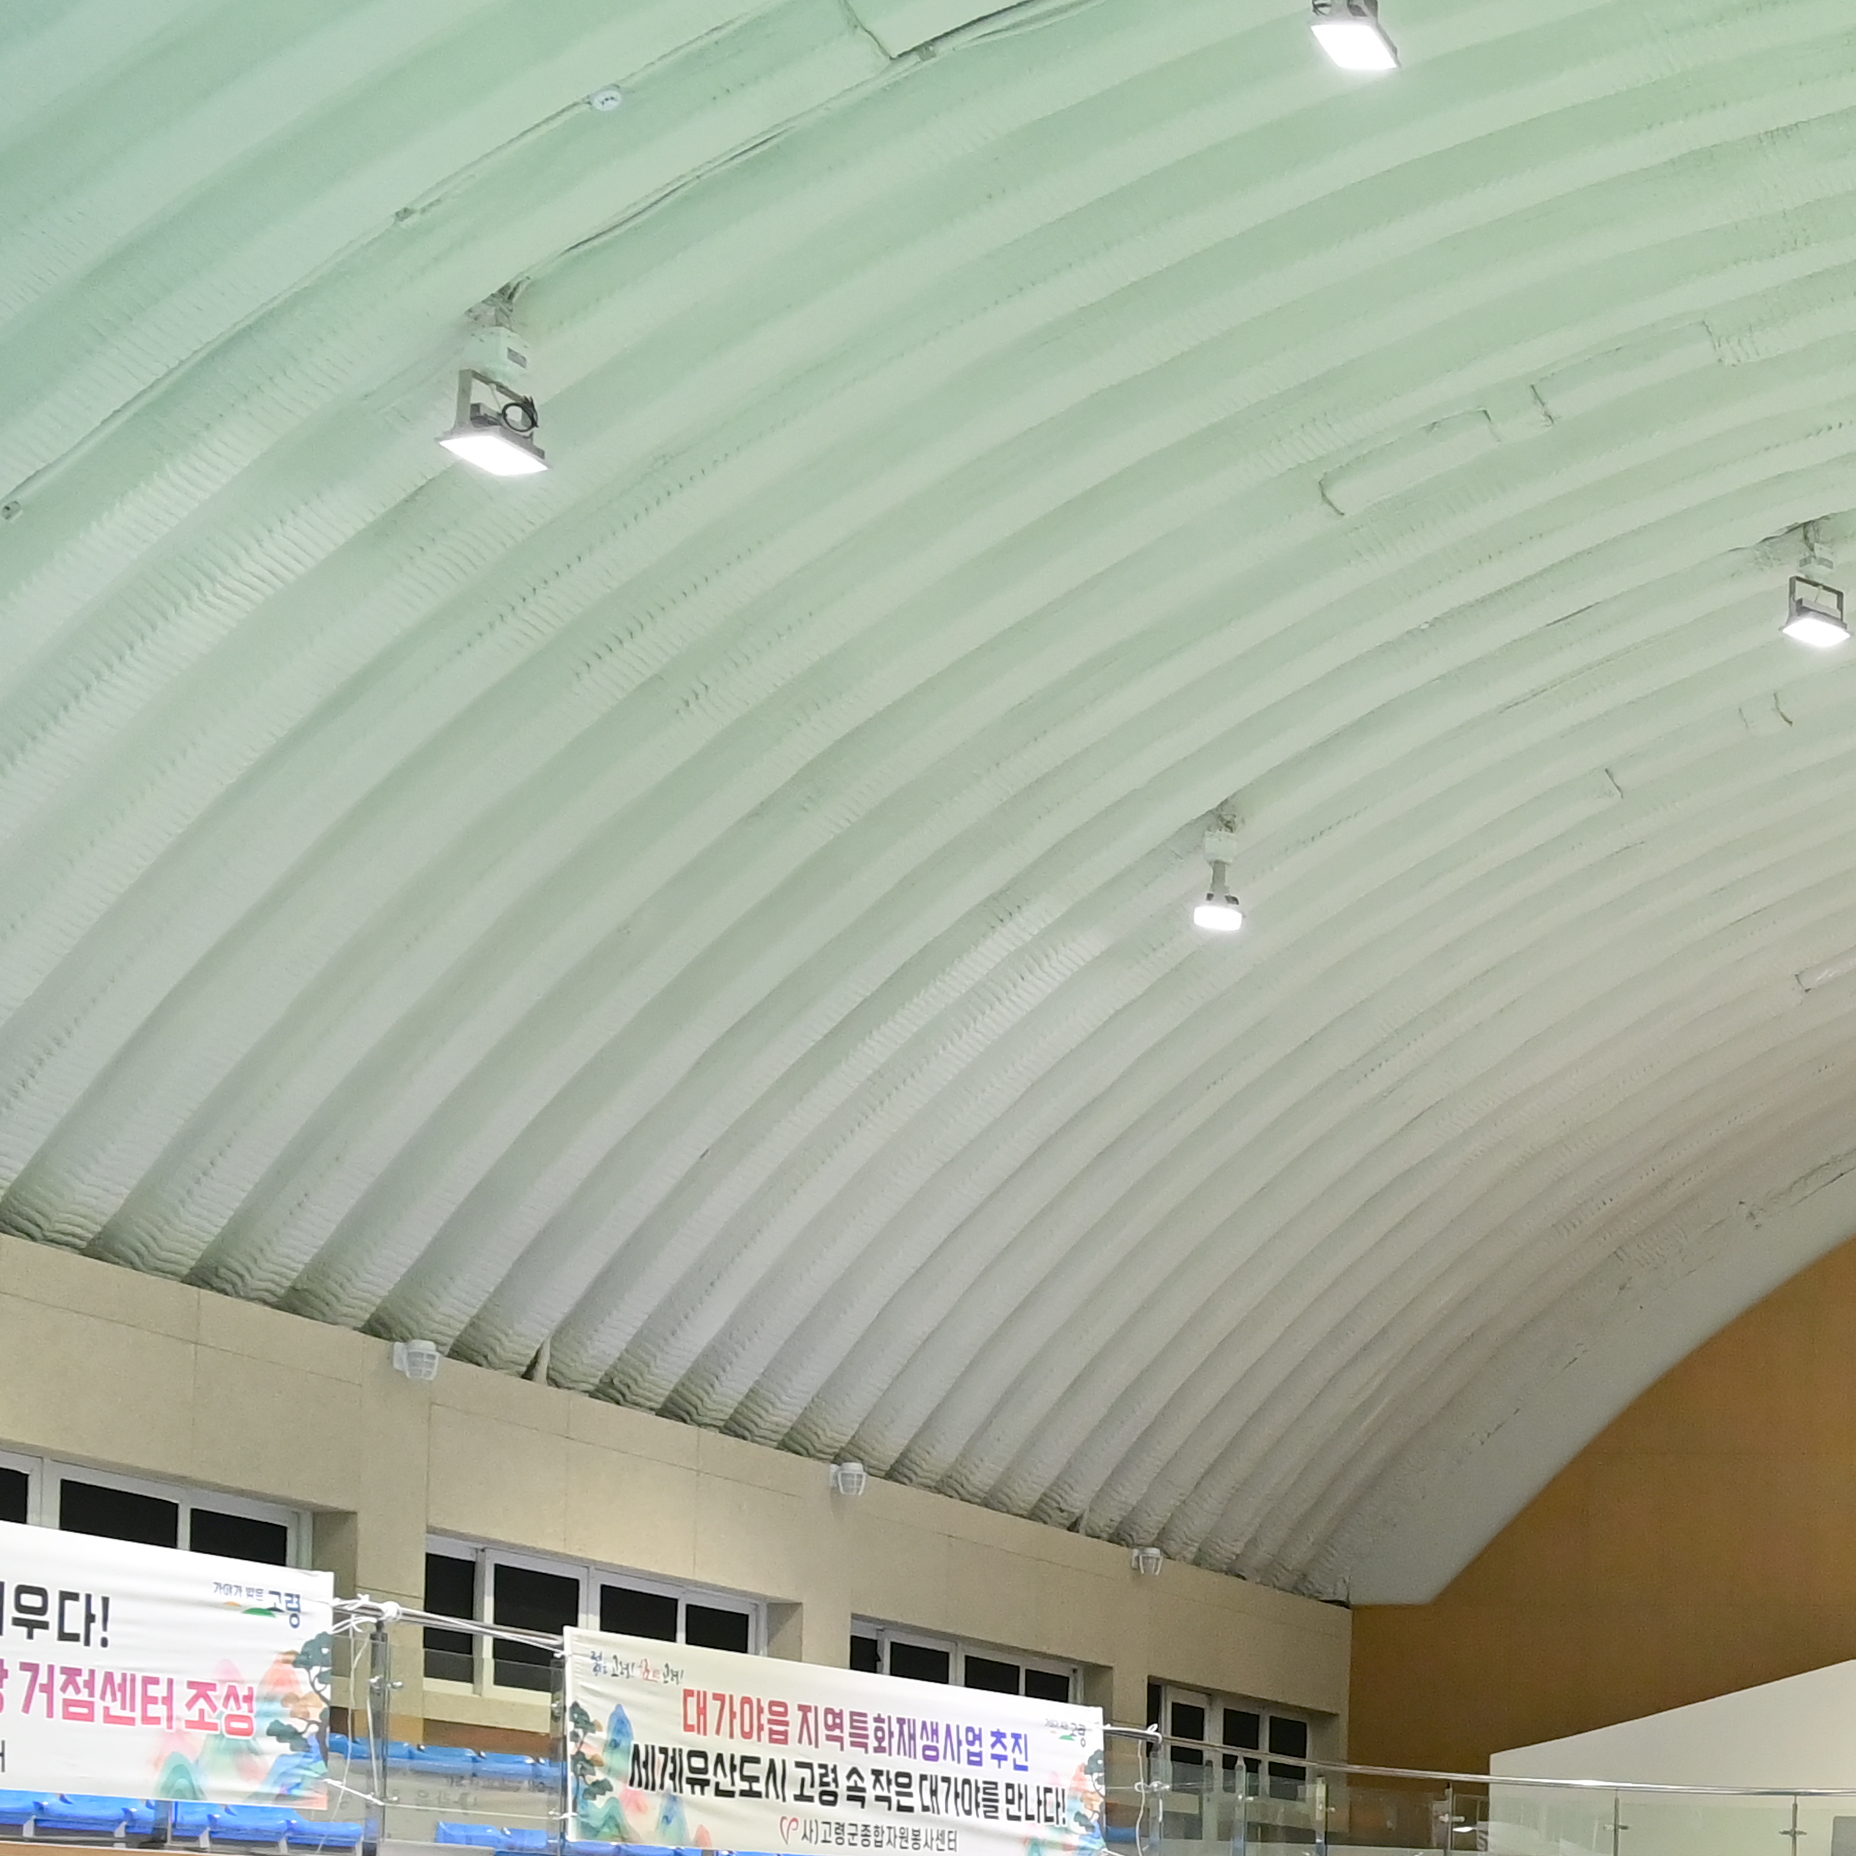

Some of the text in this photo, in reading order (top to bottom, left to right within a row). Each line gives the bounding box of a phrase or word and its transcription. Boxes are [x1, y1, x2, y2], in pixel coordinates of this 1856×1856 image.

[0, 1581, 110, 1648] 우다!
[213, 1581, 243, 1598] 가야가
[268, 1590, 301, 1629] 고령
[19, 1661, 174, 1730] 거점센터
[184, 1680, 255, 1737] 조성
[683, 1688, 1029, 1772] 대가야읍 지역특화재생사업 추진
[629, 1743, 787, 1803] 세계유산도시
[793, 1761, 839, 1807] 고령
[1005, 1782, 1067, 1826] 만나다!
